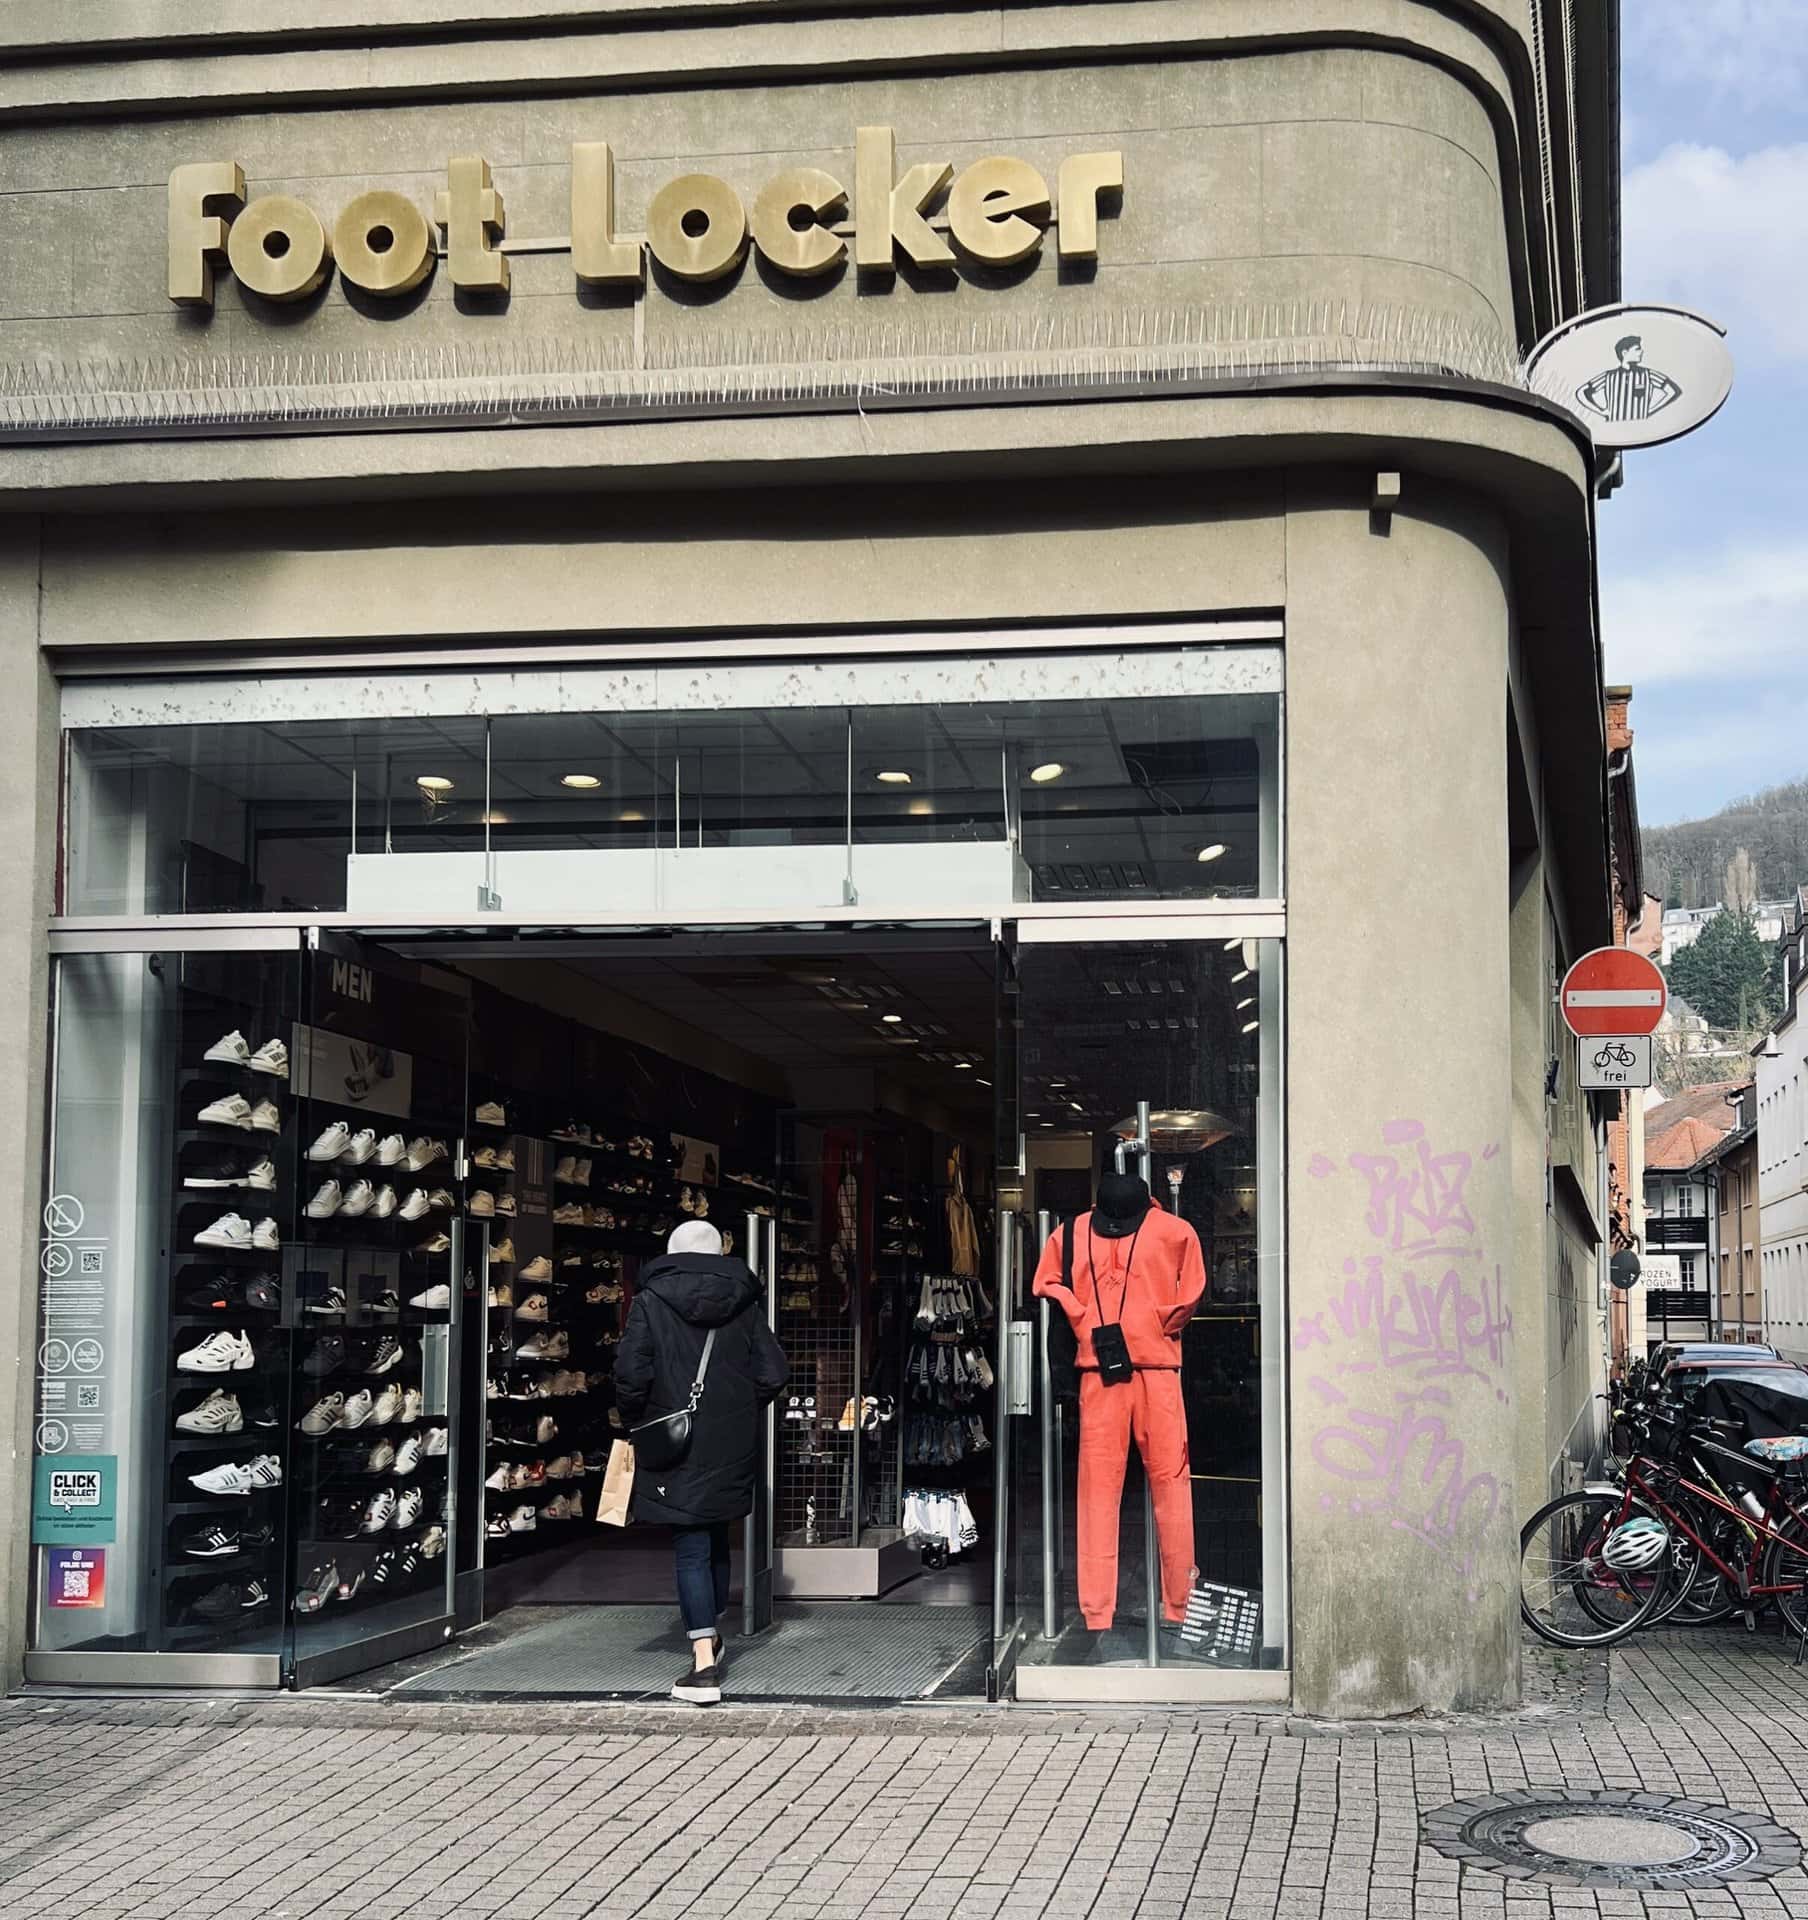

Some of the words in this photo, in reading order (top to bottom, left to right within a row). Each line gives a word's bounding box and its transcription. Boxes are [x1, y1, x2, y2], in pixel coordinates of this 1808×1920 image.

[571, 125, 1123, 286] Locker
[332, 958, 373, 1003] MEN
[1604, 1070, 1627, 1082] frei
[1640, 1270, 1672, 1278] ROZEN
[1640, 1279, 1678, 1287] YOGURT
[54, 1475, 96, 1488] CLICK
[54, 1489, 60, 1497] &
[62, 1489, 96, 1497] COLLECT
